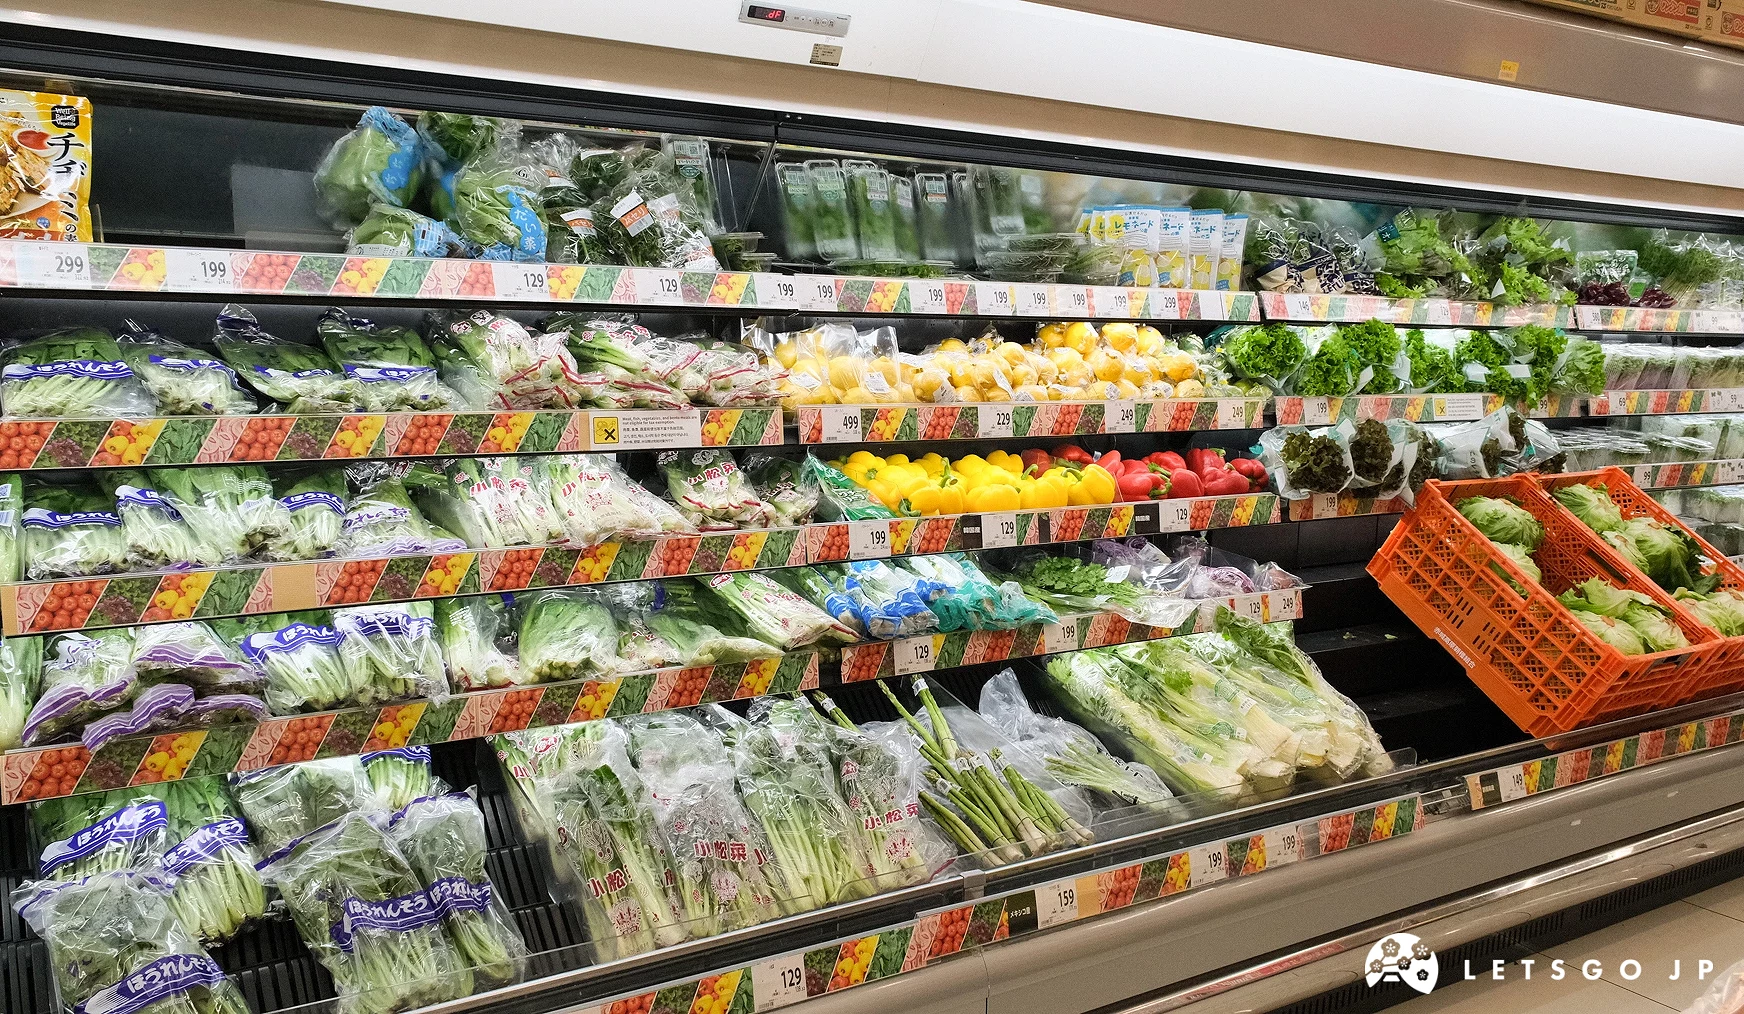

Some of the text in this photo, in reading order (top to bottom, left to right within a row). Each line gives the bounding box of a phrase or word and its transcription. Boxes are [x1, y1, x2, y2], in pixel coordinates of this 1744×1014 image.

[1114, 219, 1154, 231] レモネード
[55, 255, 84, 274] 299
[201, 261, 227, 278] 199
[523, 273, 544, 288] 129
[659, 278, 678, 293] 129
[777, 283, 794, 297] 199
[817, 284, 833, 299] 199
[928, 287, 943, 302] 199
[993, 290, 1008, 304] 199
[1032, 292, 1046, 305] 199
[1072, 293, 1086, 306] 199
[1114, 295, 1127, 308] 199
[1164, 296, 1177, 309] 299
[1299, 300, 1310, 312] 146
[1316, 402, 1327, 414] 199
[1619, 397, 1626, 407] 69
[996, 412, 1011, 426] 229
[1120, 408, 1134, 421] 249
[1232, 406, 1243, 418] 249
[842, 415, 859, 430] 499
[1643, 471, 1651, 480] 99
[291, 494, 339, 503] ほうれん
[1325, 497, 1336, 508] 199
[56, 511, 119, 522] ほうれん
[1175, 508, 1188, 521] 129
[1000, 521, 1015, 535] 129
[870, 530, 886, 545] 199
[1249, 602, 1260, 614] 129
[1282, 597, 1294, 610] 249
[282, 625, 335, 642] ほうれん
[1061, 625, 1075, 639] 199
[914, 644, 929, 660] 129
[1512, 773, 1523, 787] 149
[863, 802, 919, 831] 小松菜
[77, 804, 162, 848] ほうれんそう
[1282, 834, 1296, 851] 199
[693, 839, 748, 863] 小松菜
[1208, 851, 1222, 869] 199
[1057, 888, 1075, 908] 159
[348, 895, 428, 918] ほうれんそう
[780, 967, 802, 989] 129
